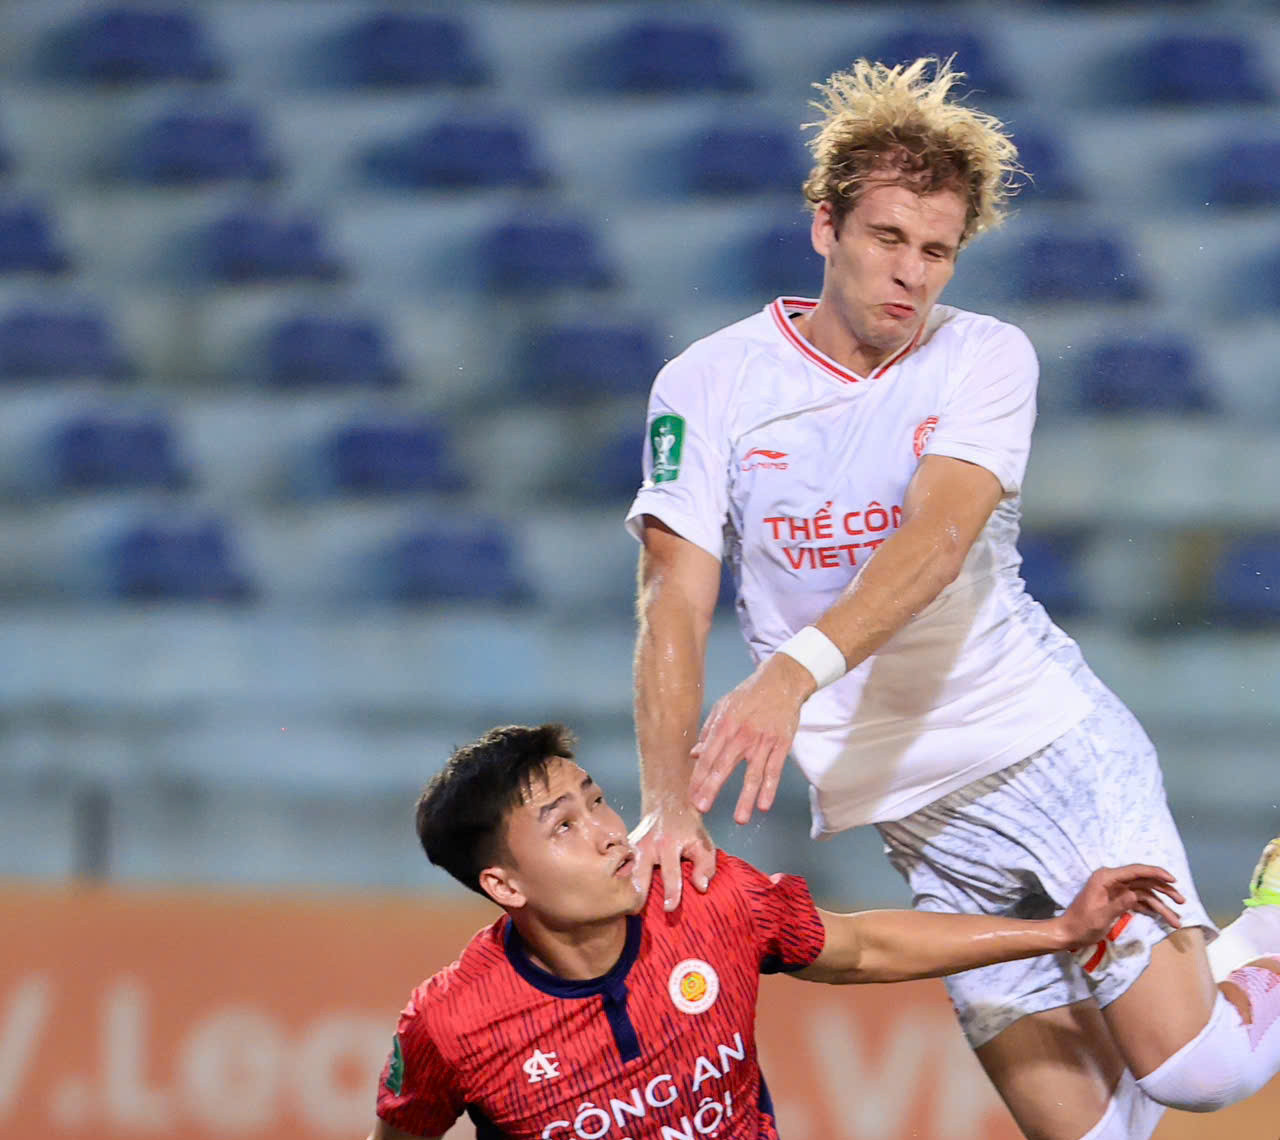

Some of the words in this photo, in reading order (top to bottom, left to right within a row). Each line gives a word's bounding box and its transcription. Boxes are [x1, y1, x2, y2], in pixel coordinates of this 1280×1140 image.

[762, 500, 834, 541] THỂ
[843, 500, 903, 536] CÔN
[781, 538, 887, 570] VIETT
[692, 1032, 746, 1092] AN
